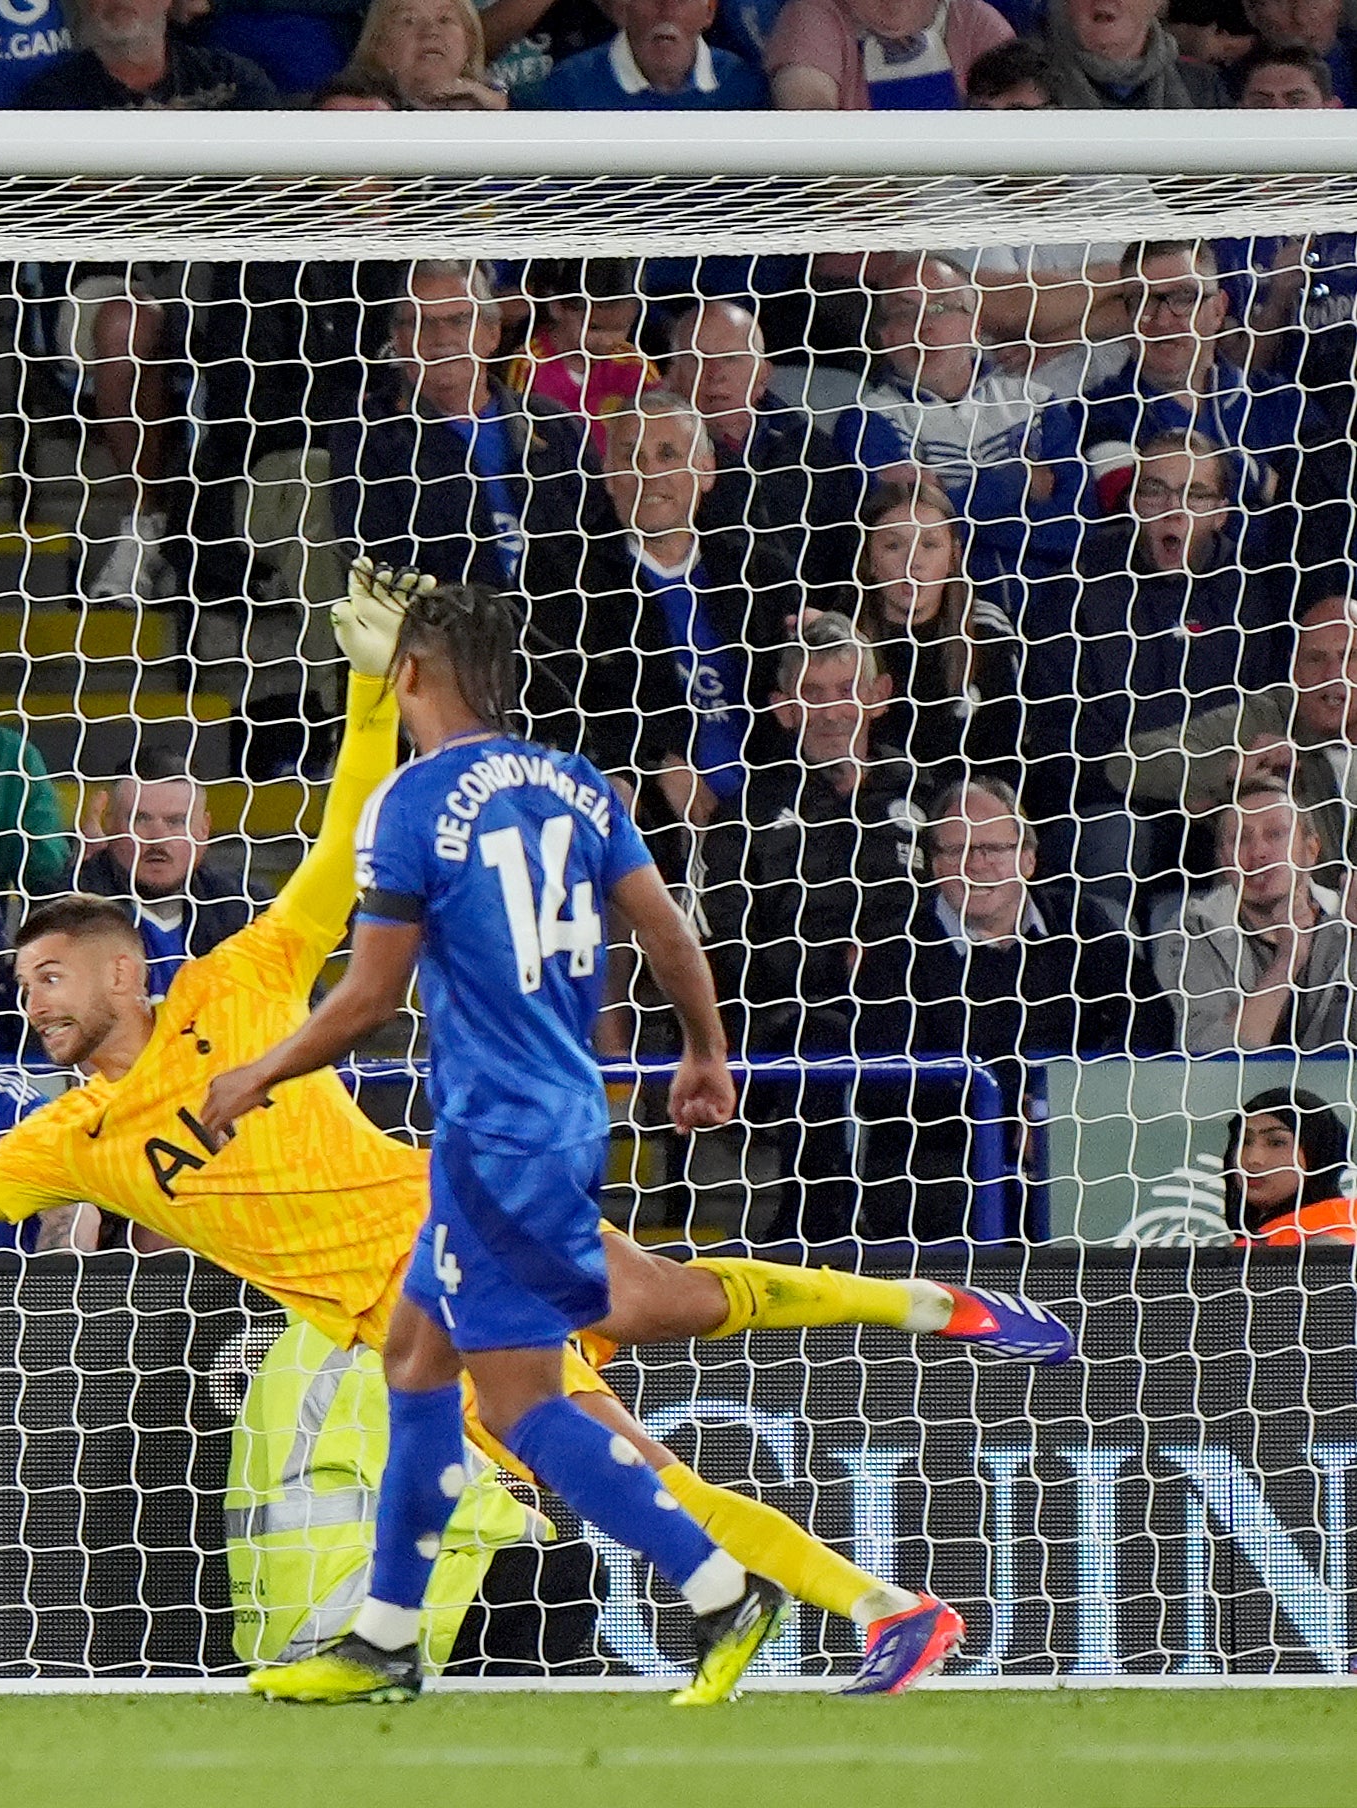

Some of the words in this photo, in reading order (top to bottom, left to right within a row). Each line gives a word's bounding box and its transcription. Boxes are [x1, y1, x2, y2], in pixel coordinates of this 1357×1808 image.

[434, 814, 471, 862] DE
[479, 814, 602, 995] 14
[433, 1223, 462, 1295] 4
